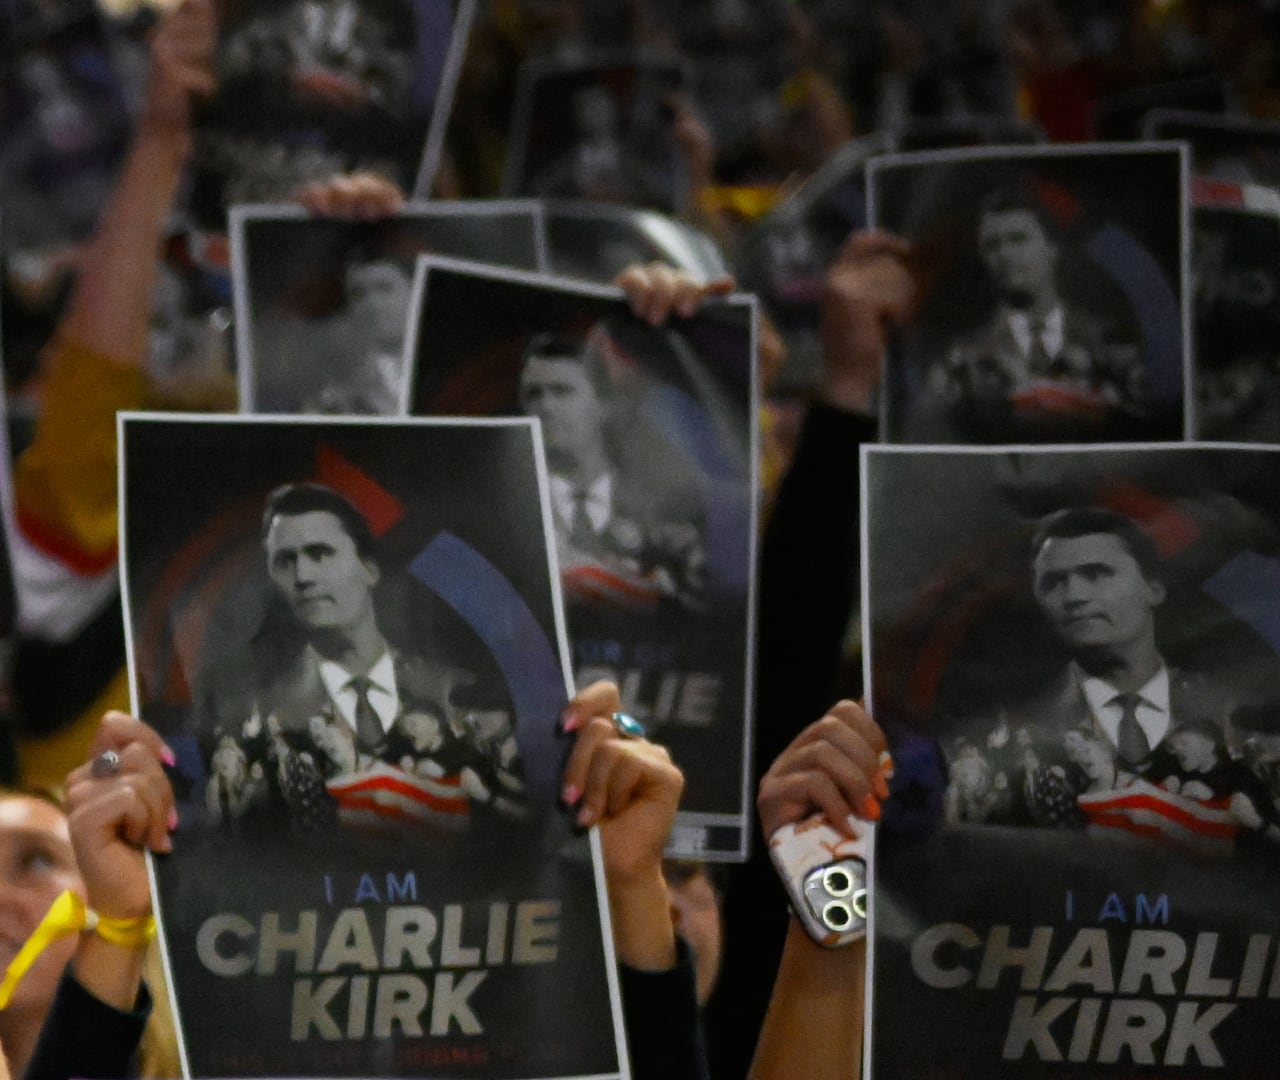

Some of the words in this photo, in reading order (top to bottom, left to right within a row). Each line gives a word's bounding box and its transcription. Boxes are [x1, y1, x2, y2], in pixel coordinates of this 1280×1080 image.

[325, 874, 333, 904] I
[356, 871, 418, 902] AM
[1065, 890, 1075, 920] I
[1099, 891, 1170, 925] AM
[196, 901, 563, 977] CHARLIE
[911, 922, 1280, 999] CHARLI
[290, 970, 489, 1042] KIRK
[1001, 996, 1238, 1069] KIRK
